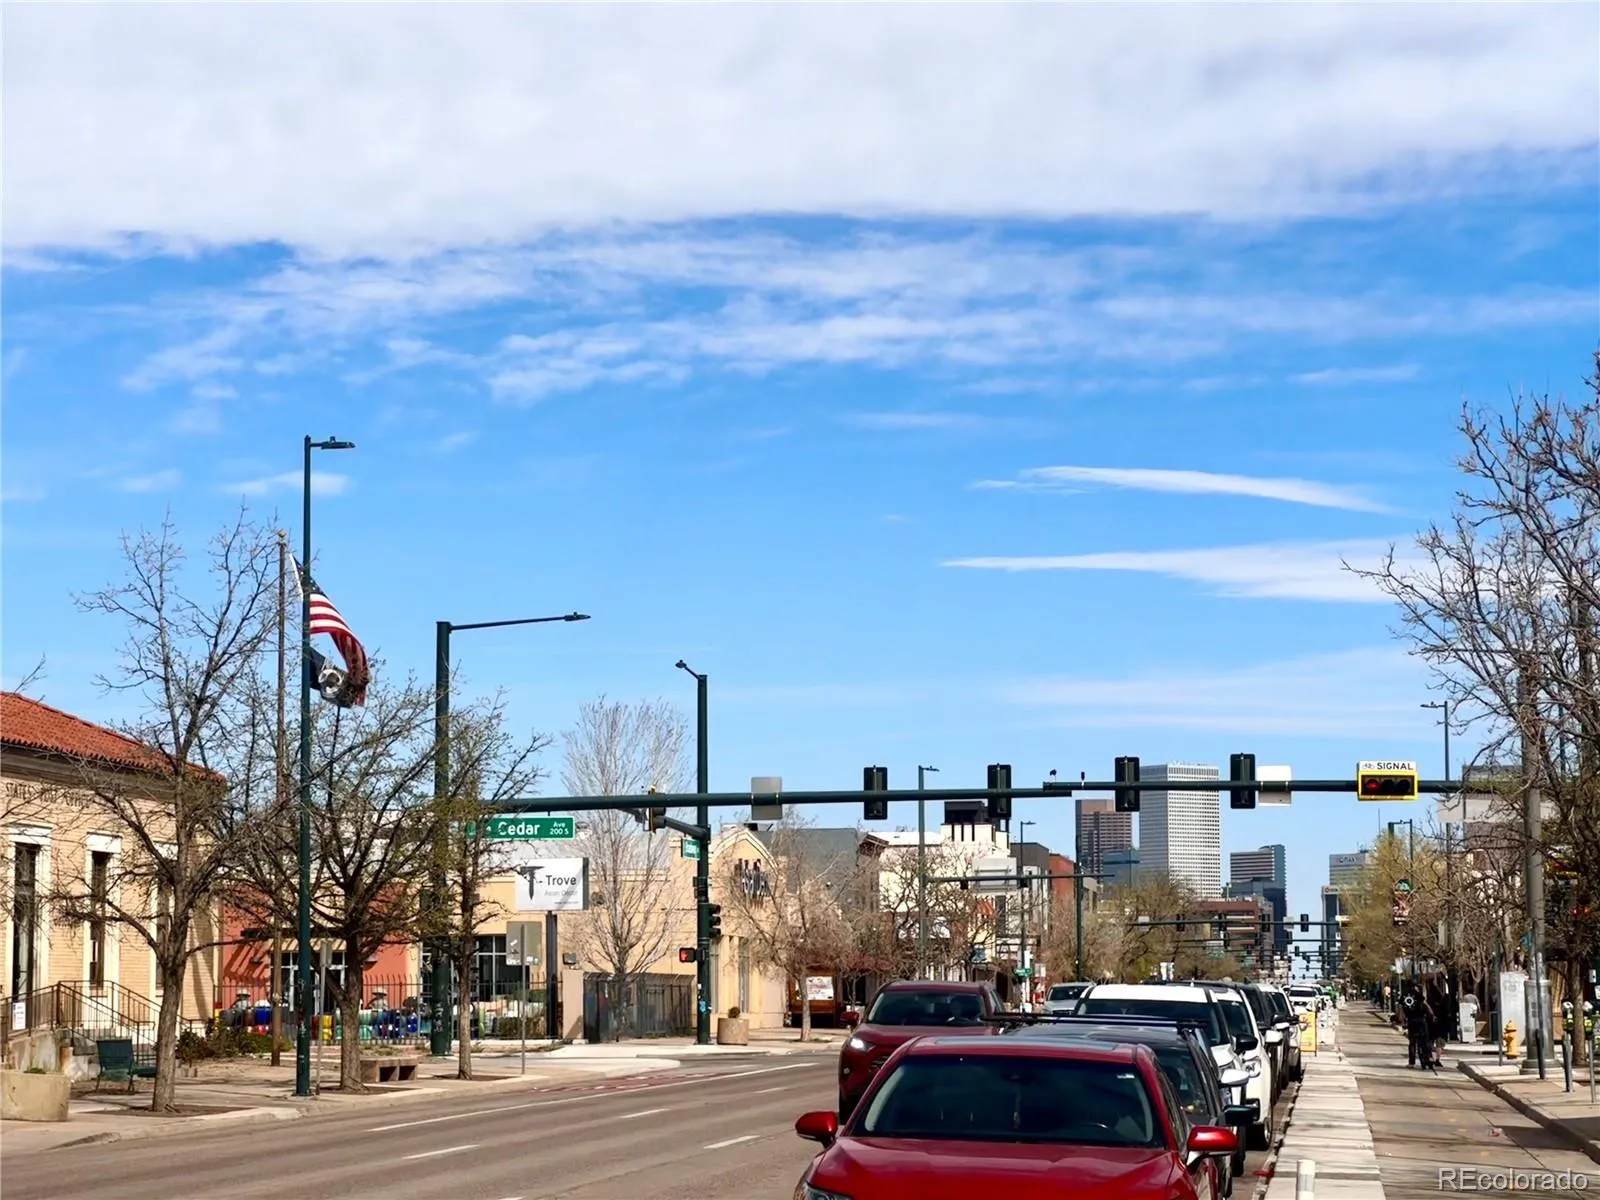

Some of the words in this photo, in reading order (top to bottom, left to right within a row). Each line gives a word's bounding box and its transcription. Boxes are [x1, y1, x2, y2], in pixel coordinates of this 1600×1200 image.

[1377, 762, 1414, 770] SIGNAL
[498, 821, 540, 835] Cedar
[545, 874, 577, 886] Trove
